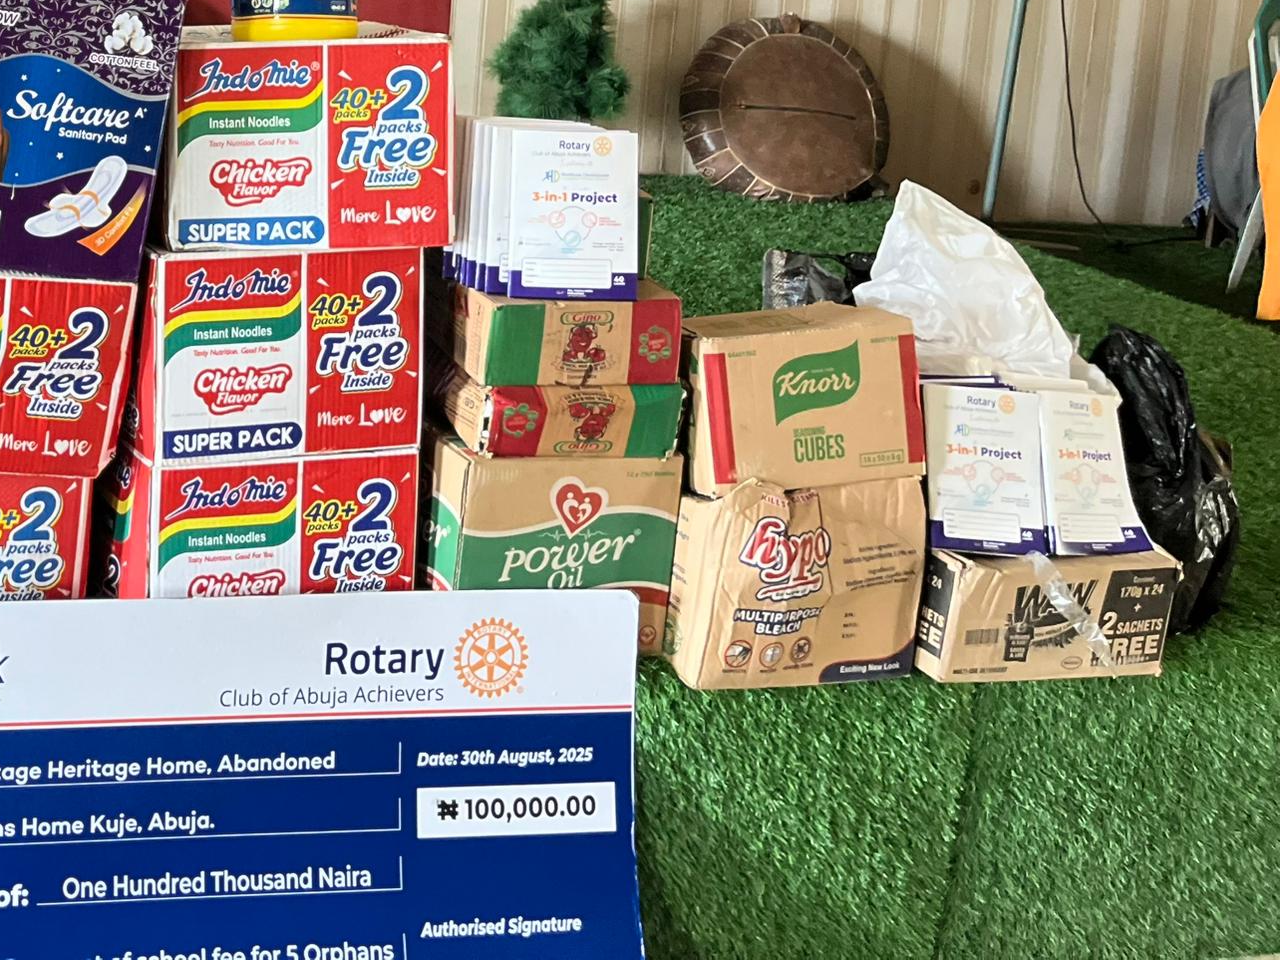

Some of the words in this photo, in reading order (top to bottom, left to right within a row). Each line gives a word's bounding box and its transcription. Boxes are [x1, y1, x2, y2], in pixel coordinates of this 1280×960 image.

[89, 53, 130, 67] COTTON
[131, 57, 160, 71] FEEL
[6, 89, 131, 131] Softcare
[209, 116, 246, 129] Instant
[248, 116, 291, 128] Noodles
[58, 126, 102, 142] Sanitary
[105, 131, 127, 145] Pad
[559, 140, 590, 152] Rotary
[338, 128, 434, 168] Free
[213, 159, 310, 185] Chicken
[366, 168, 418, 184] Inside
[232, 183, 278, 196] Flavor
[532, 191, 567, 202] 3-in-1
[571, 192, 618, 205] Project
[188, 221, 250, 242] SUPER
[256, 220, 316, 240] PACK
[572, 313, 602, 323] Gino
[776, 370, 856, 397] Knorr
[967, 395, 996, 408] Rotary
[173, 432, 232, 453] SUPER
[238, 427, 293, 448] PACK
[793, 434, 845, 463] CUBES
[946, 444, 978, 455] 3-in-1
[981, 447, 1022, 460] Project
[1151, 584, 1164, 595] 24
[756, 620, 801, 635] BLEACH
[1102, 612, 1116, 635] 2
[1116, 618, 1163, 635] SACHETS
[325, 642, 445, 680] Rotary
[220, 688, 263, 708] Club
[269, 687, 288, 706] of
[293, 687, 347, 708] Abuja
[354, 685, 444, 704] Achievers
[48, 759, 141, 781] Heritage
[147, 756, 212, 777] Home,
[218, 751, 335, 773] Abandoned
[417, 751, 458, 768] Date:
[461, 750, 495, 766] 30th
[498, 749, 556, 767] August,
[558, 747, 593, 763] 2025
[464, 794, 596, 823] 100,000.00
[22, 818, 84, 836] Home
[90, 814, 143, 837] Kuje,
[148, 811, 215, 832] Abuja.
[62, 877, 106, 899] One
[113, 872, 205, 897] Hundred
[211, 867, 313, 893] Thousand
[318, 865, 372, 889] Naira
[420, 918, 506, 938] Authorised
[508, 916, 582, 937] Signature
